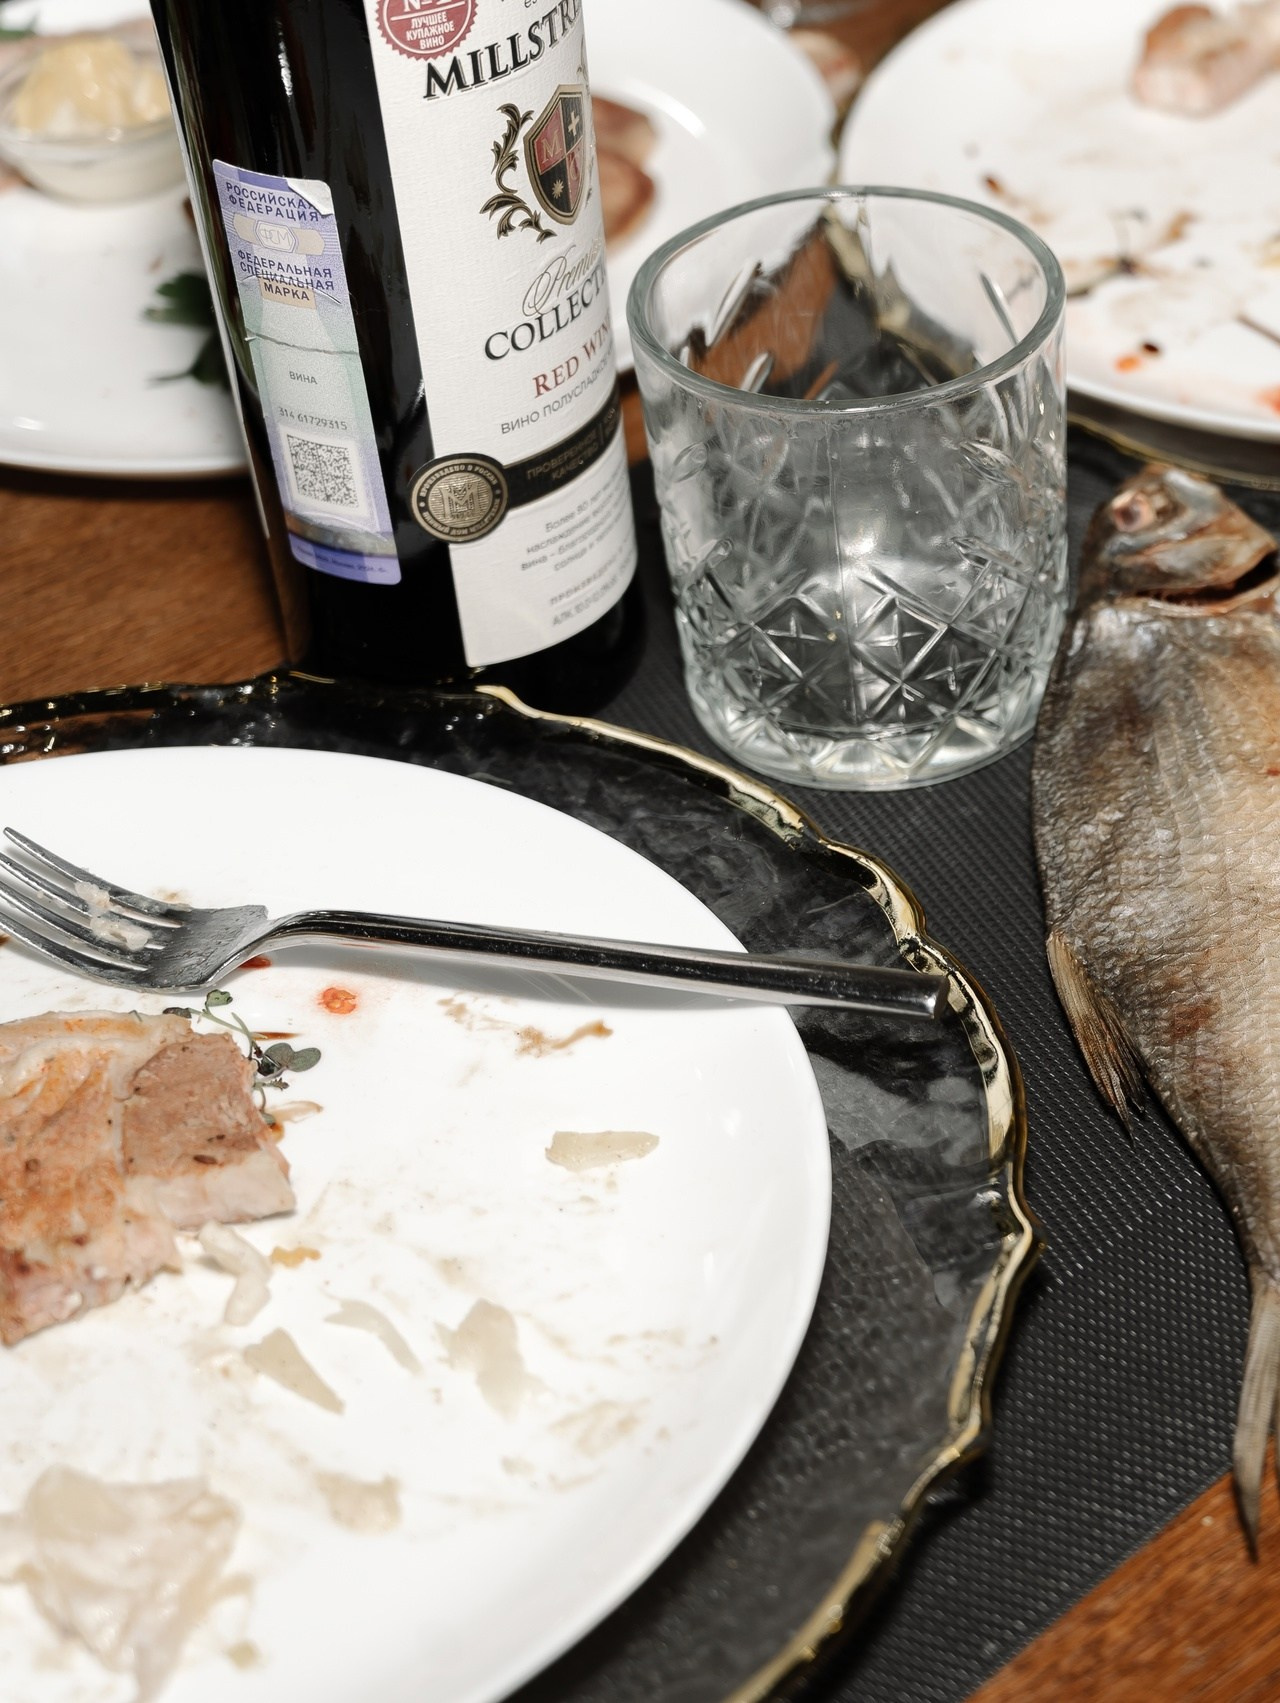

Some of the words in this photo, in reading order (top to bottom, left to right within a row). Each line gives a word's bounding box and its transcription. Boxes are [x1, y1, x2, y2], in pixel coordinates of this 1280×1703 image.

[406, 20, 455, 41] КУПАЖНОЕ
[411, 11, 447, 29] ЛУЧШЕЕ
[420, 35, 445, 50] ВИНО
[228, 194, 319, 222] ФЕДЕРАЦИЯ
[238, 249, 333, 279] ФЕДЕРАЛЬНАЯ
[240, 261, 334, 291] СПЕЦИАЛЬНАЯ
[264, 282, 310, 301] МАРКА
[289, 371, 318, 385] ВИНА
[532, 356, 580, 399] RED
[501, 410, 540, 435] ВИНО
